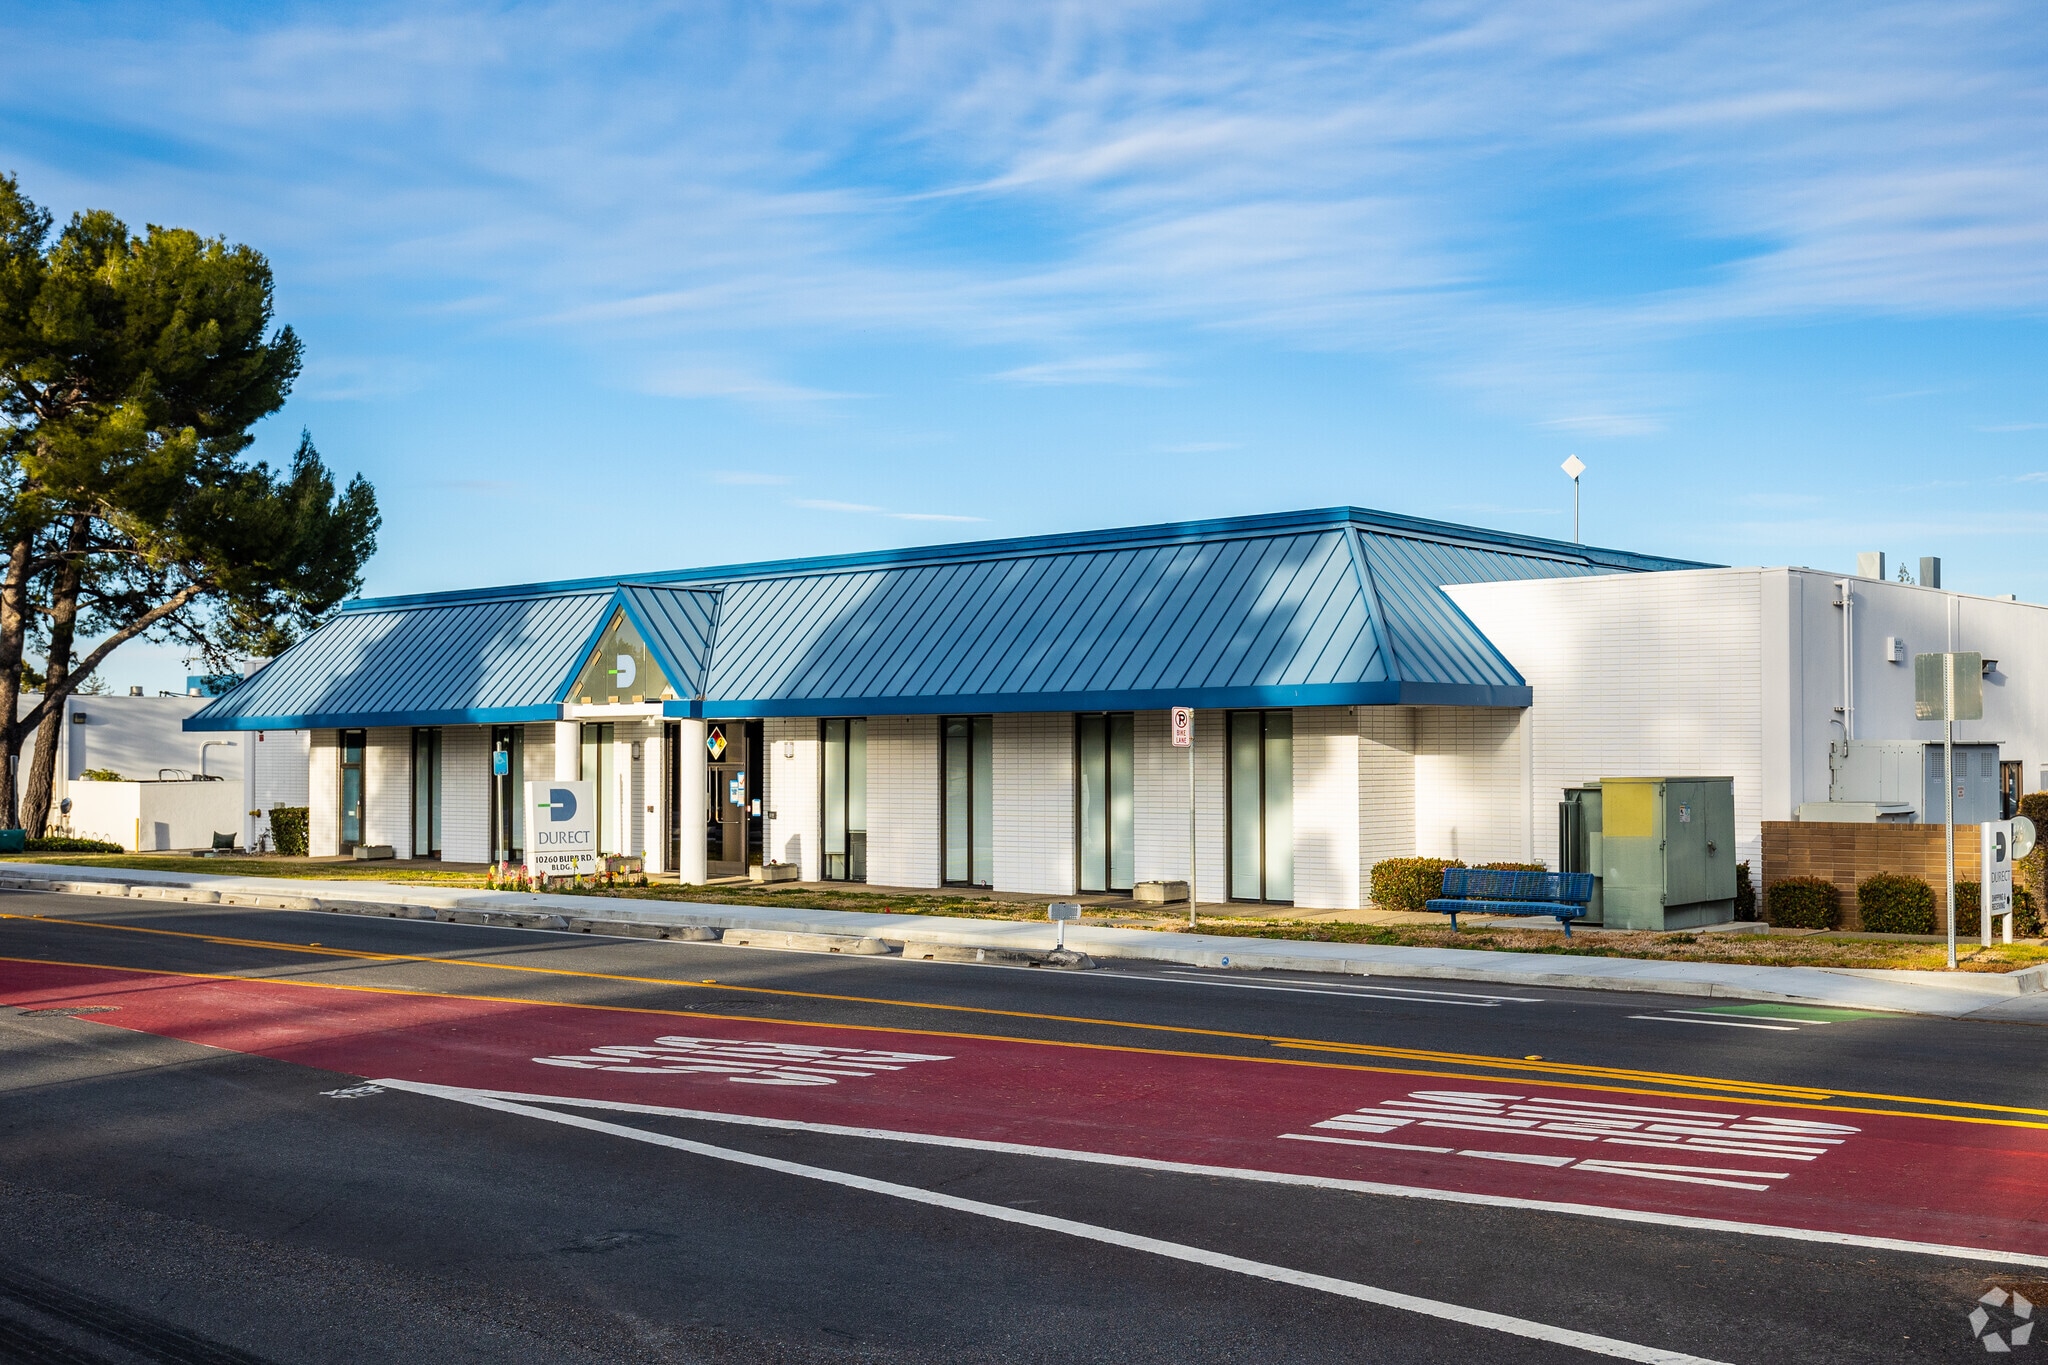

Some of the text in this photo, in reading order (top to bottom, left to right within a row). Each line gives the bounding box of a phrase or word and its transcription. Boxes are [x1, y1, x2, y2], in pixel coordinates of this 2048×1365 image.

[538, 830, 590, 845] DURECT
[535, 855, 558, 864] 10260
[581, 854, 594, 862] RD.
[1991, 870, 2010, 883] DURECT
[532, 1036, 956, 1086] BUS
[1277, 1090, 1863, 1192] ONLY
